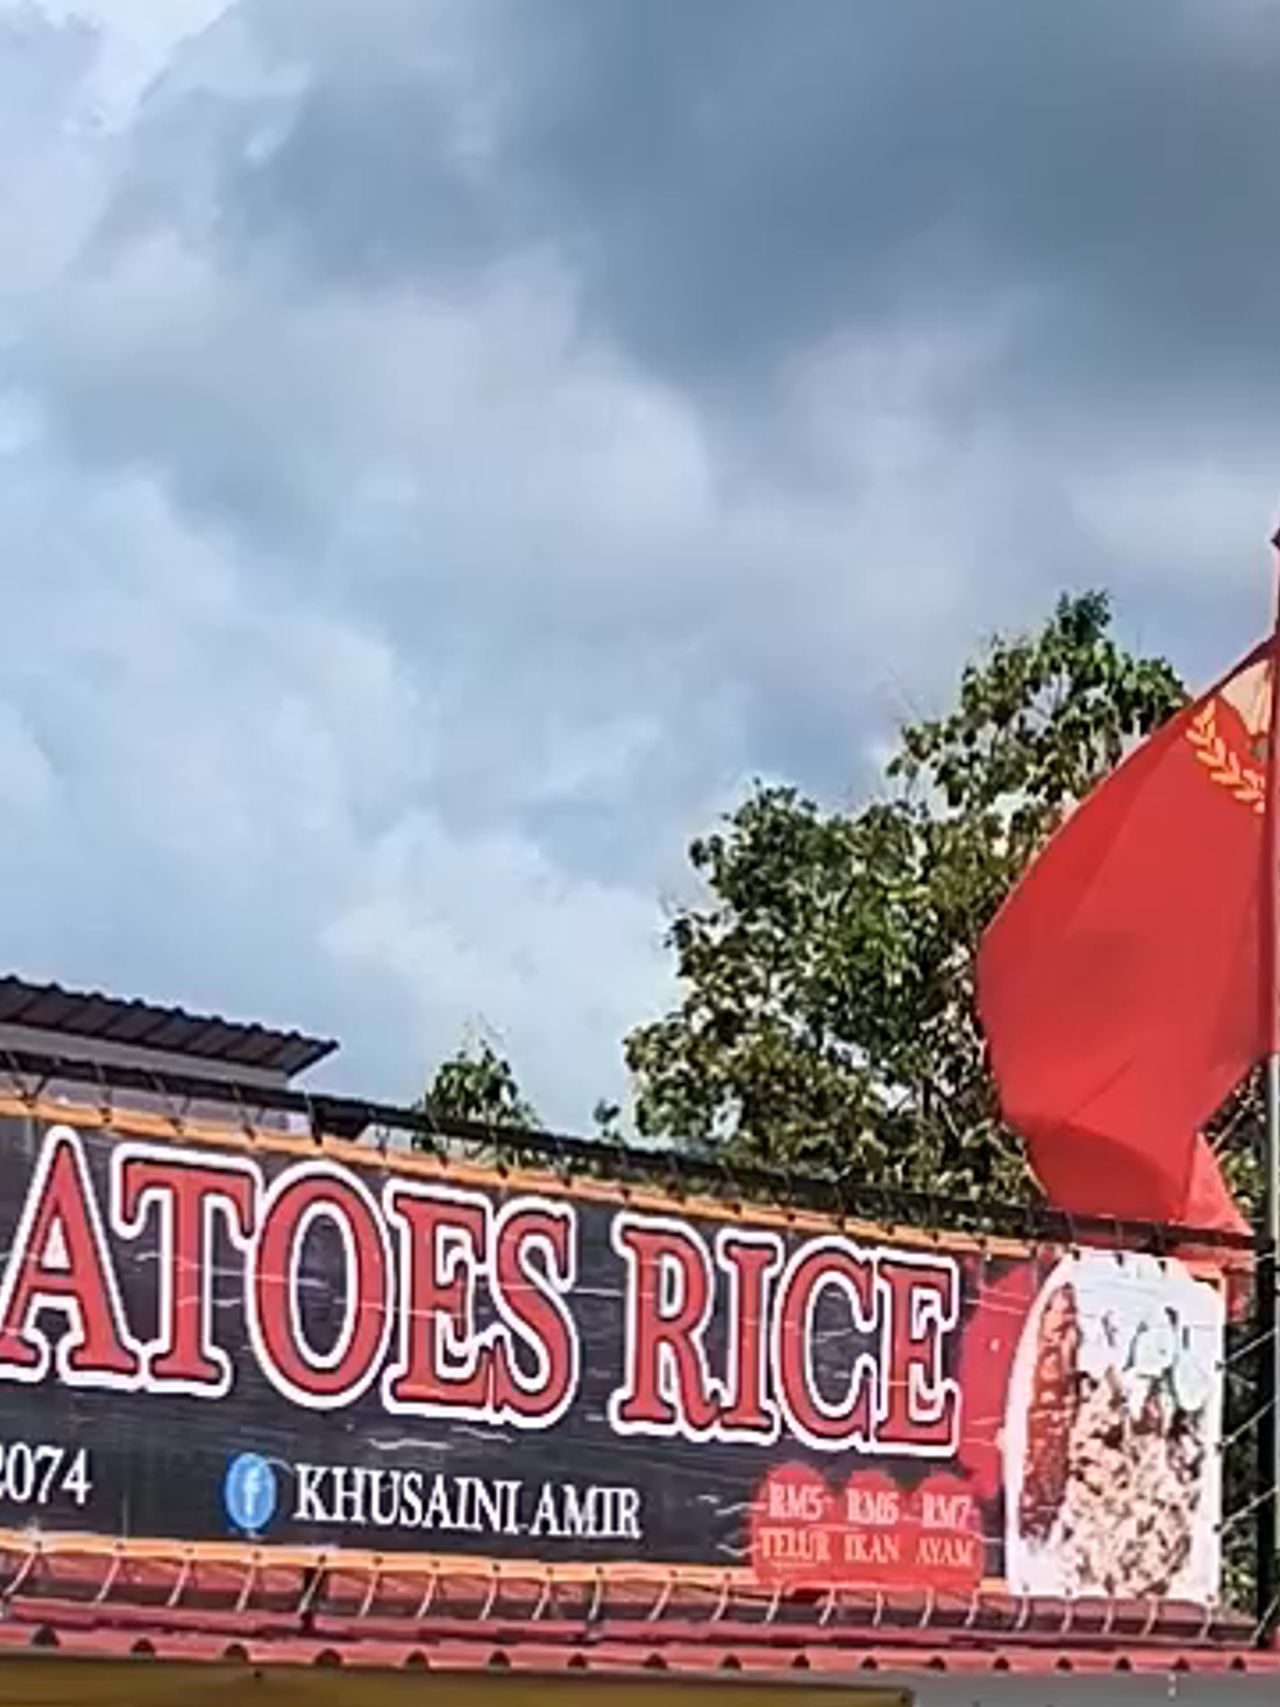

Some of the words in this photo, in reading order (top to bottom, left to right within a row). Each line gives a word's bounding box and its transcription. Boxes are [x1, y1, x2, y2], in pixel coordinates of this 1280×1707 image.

[609, 1220, 962, 1461] RICE
[290, 1465, 522, 1534] KHUSAINI
[523, 1483, 642, 1541] AMIR
[769, 1481, 823, 1521] RM5
[845, 1487, 900, 1525] RM6
[922, 1493, 972, 1529] RM7
[758, 1526, 831, 1562] TELUR
[845, 1532, 900, 1565] IKAN
[915, 1537, 974, 1566] AYAM
